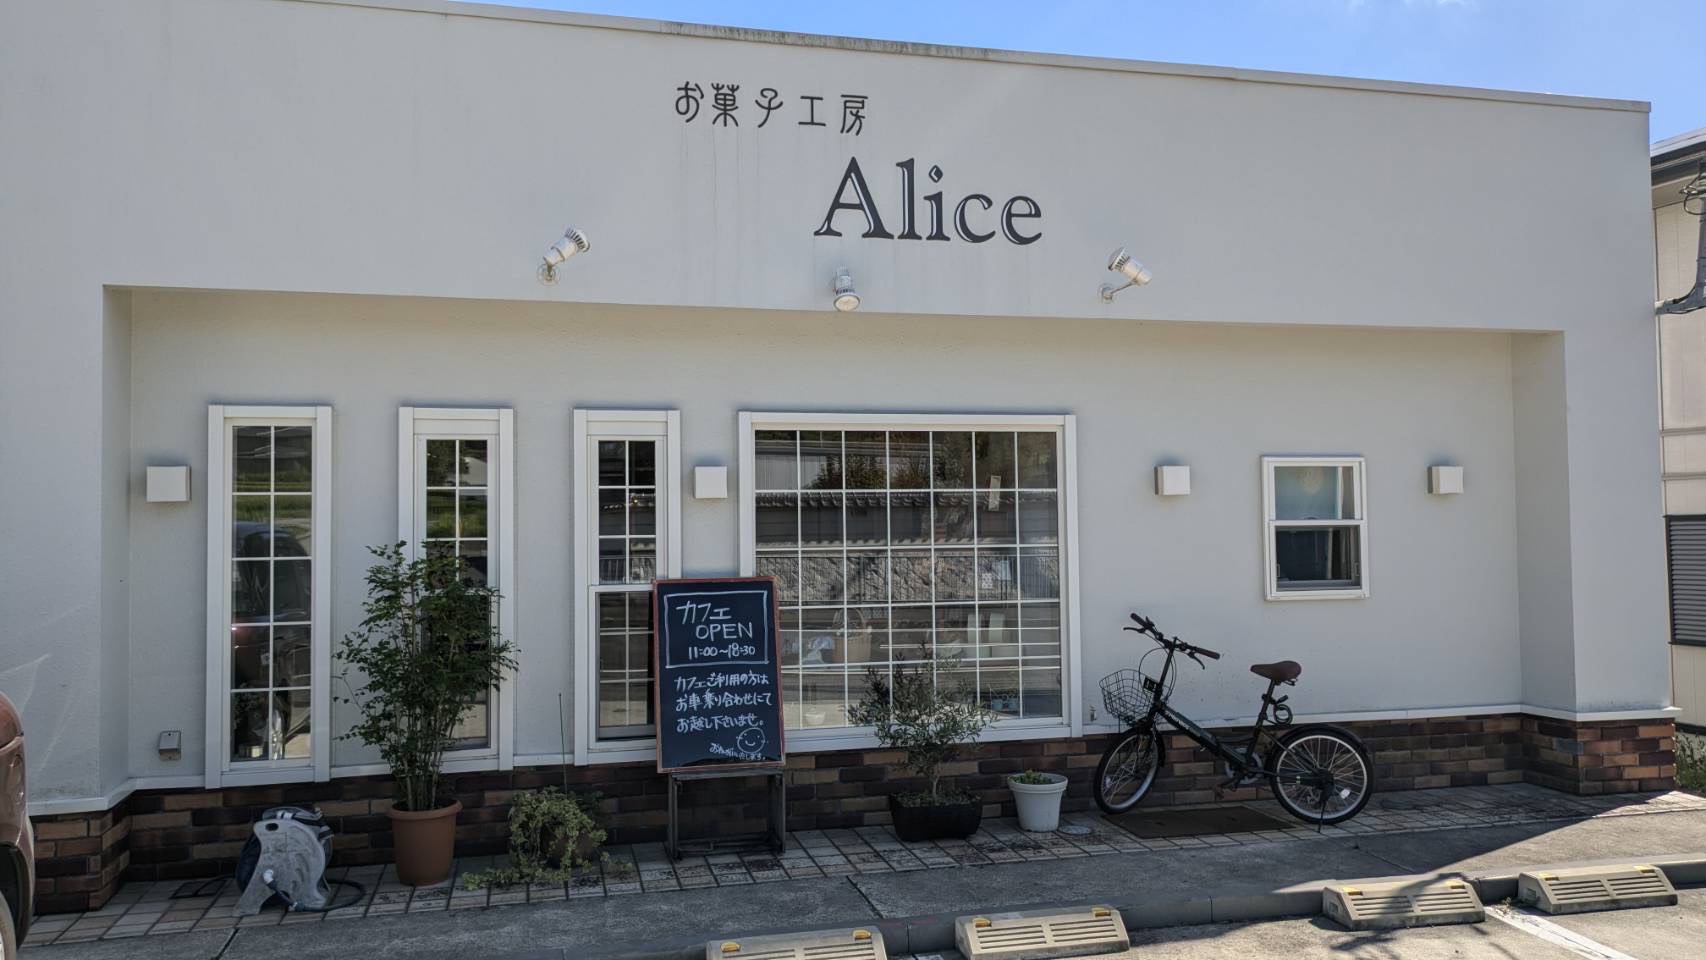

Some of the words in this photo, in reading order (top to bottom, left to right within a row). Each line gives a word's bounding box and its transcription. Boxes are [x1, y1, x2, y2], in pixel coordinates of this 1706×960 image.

[675, 81, 868, 136] お菓子工房
[813, 156, 1042, 245] Alice
[675, 600, 732, 625] カフェ
[696, 622, 753, 641] OPEN
[674, 670, 769, 691] カフェご利用の方は
[675, 688, 773, 712] お車乗り合わせにて
